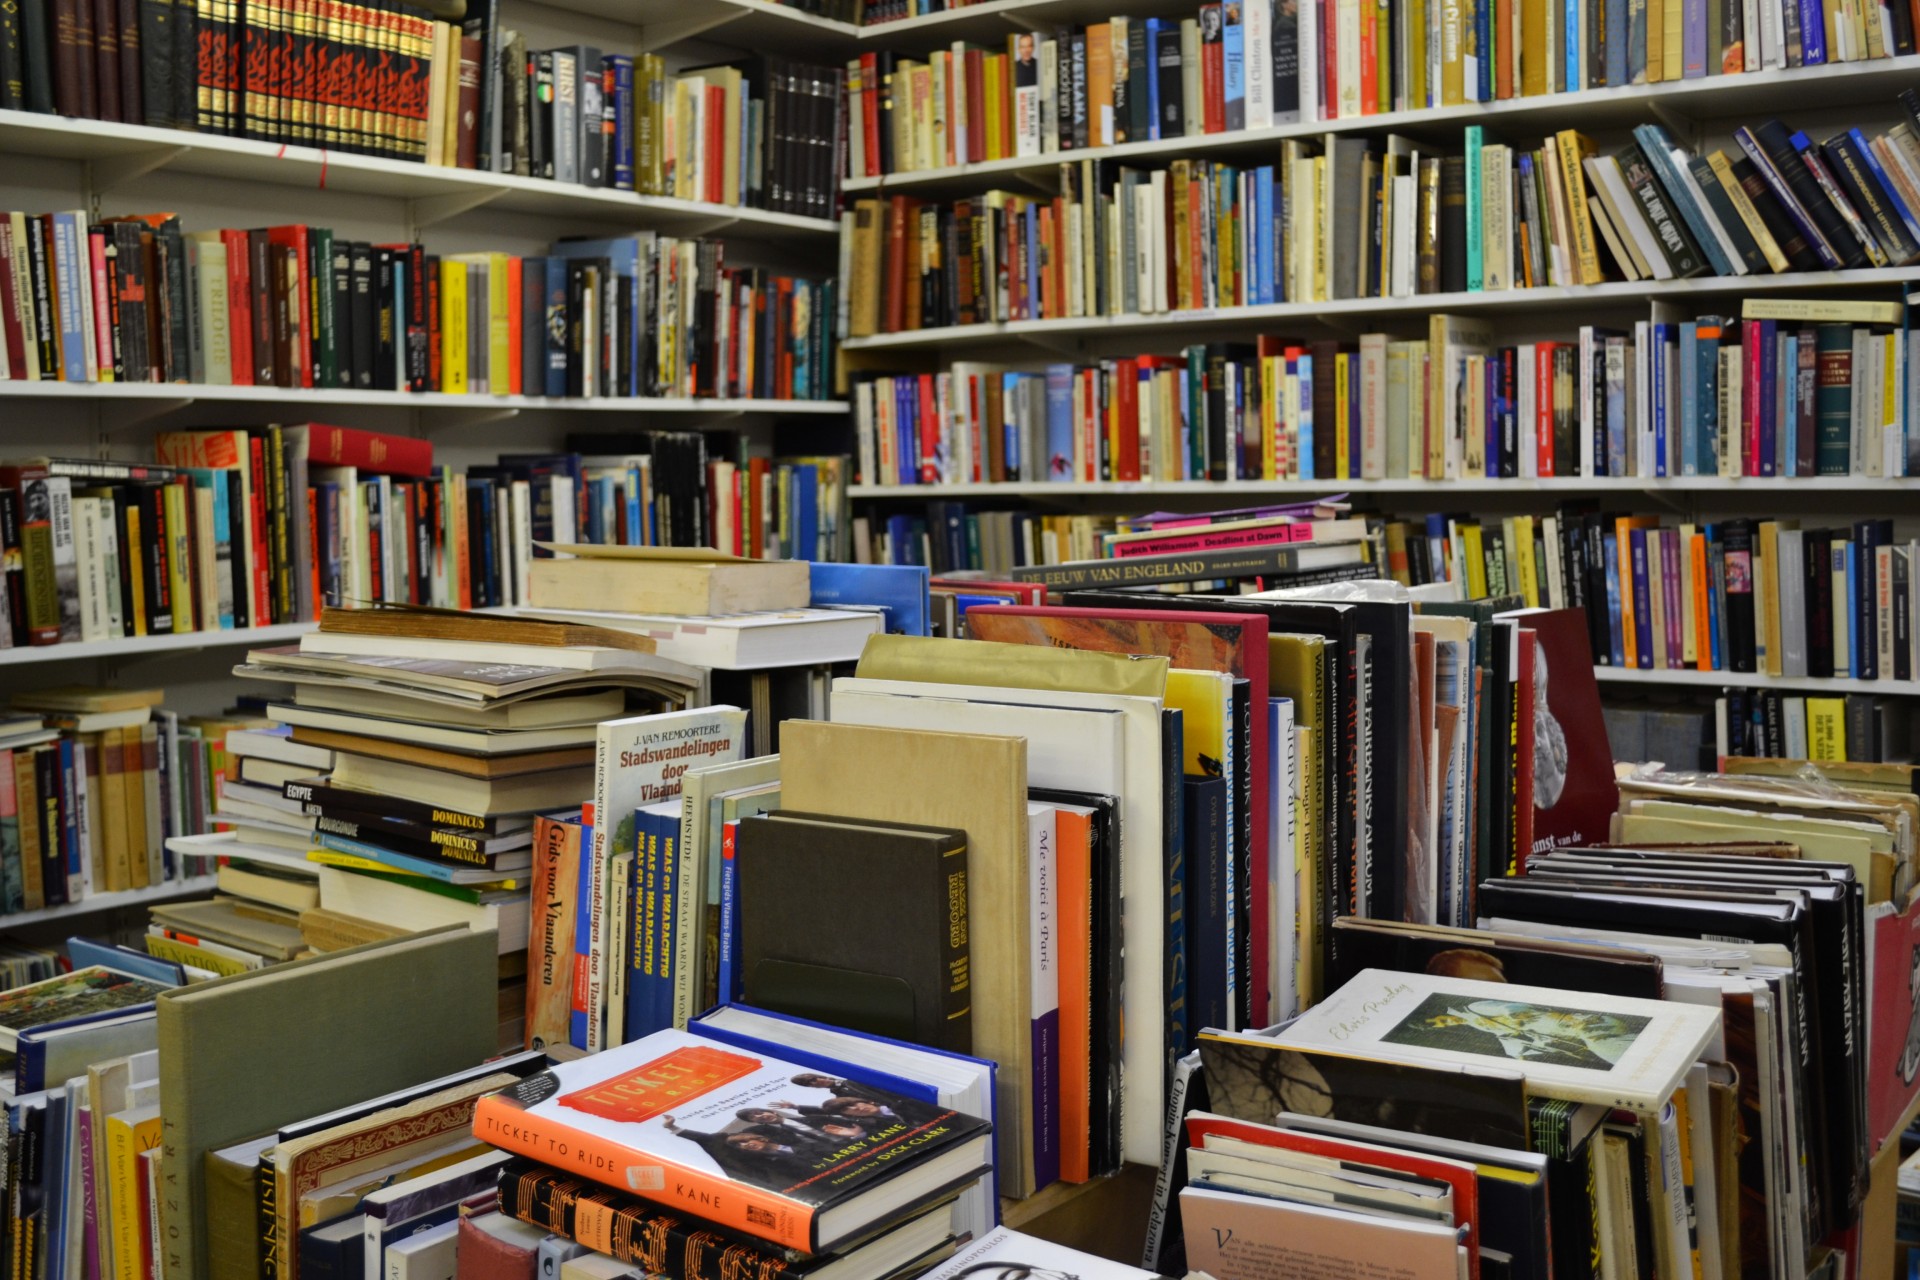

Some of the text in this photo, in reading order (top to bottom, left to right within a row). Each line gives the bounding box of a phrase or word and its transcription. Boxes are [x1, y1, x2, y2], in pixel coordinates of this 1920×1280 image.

[1072, 42, 1086, 125] SVETLANA
[1121, 542, 1147, 558] Judith
[1148, 539, 1200, 555] Williamson
[1204, 532, 1246, 548] Deadline
[1247, 533, 1256, 544] at
[1258, 529, 1283, 543] Dawn
[1044, 568, 1087, 586] EEUW
[1092, 565, 1122, 582] VAN
[1124, 561, 1206, 580] ENGELAND
[1364, 662, 1373, 703] THE
[661, 723, 721, 742] REMOORTERE
[620, 737, 731, 768] Stadswandelingen
[662, 763, 689, 780] door
[1364, 706, 1373, 820] FAIRBANKS
[287, 784, 313, 801] EGYPTE
[640, 778, 683, 802] Vlaand
[318, 816, 360, 838] BOURGONDIE
[432, 809, 486, 830] DOMINICUS
[684, 794, 694, 866] HEEMSTEDE
[430, 830, 478, 851] DOMINICUS
[1533, 835, 1556, 856] unst
[591, 832, 606, 943] Stadswandelingen
[637, 868, 644, 884] en
[646, 873, 655, 887] en
[663, 875, 671, 891] en
[682, 874, 690, 888] DE
[543, 823, 566, 986] Gids voor Vlaanderen
[681, 889, 690, 928] STRAAT
[721, 866, 732, 963] Fietsgids Vlaams-Brabant
[948, 872, 961, 949] RECORD
[1038, 830, 1051, 972] Me voici à Paris
[643, 890, 656, 975] WAARACHTIG
[660, 892, 672, 978] WAARACHTIG
[679, 931, 689, 971] WAARIN
[591, 948, 601, 977] door
[588, 981, 601, 1048] Vlaanderen
[677, 993, 686, 1029] WONEN
[584, 1062, 695, 1106] TICKET
[626, 1072, 721, 1113] TO RIDE
[823, 1140, 868, 1164] LARRY
[867, 1123, 908, 1143] KANE
[877, 1143, 912, 1161] DICK
[908, 1126, 951, 1146] CLARK
[1160, 1077, 1185, 1176] Chopin-Konzert
[486, 1117, 721, 1210] TICKET TO RIDE KANE
[164, 1118, 181, 1269] MOZART
[1154, 1180, 1165, 1198] in
